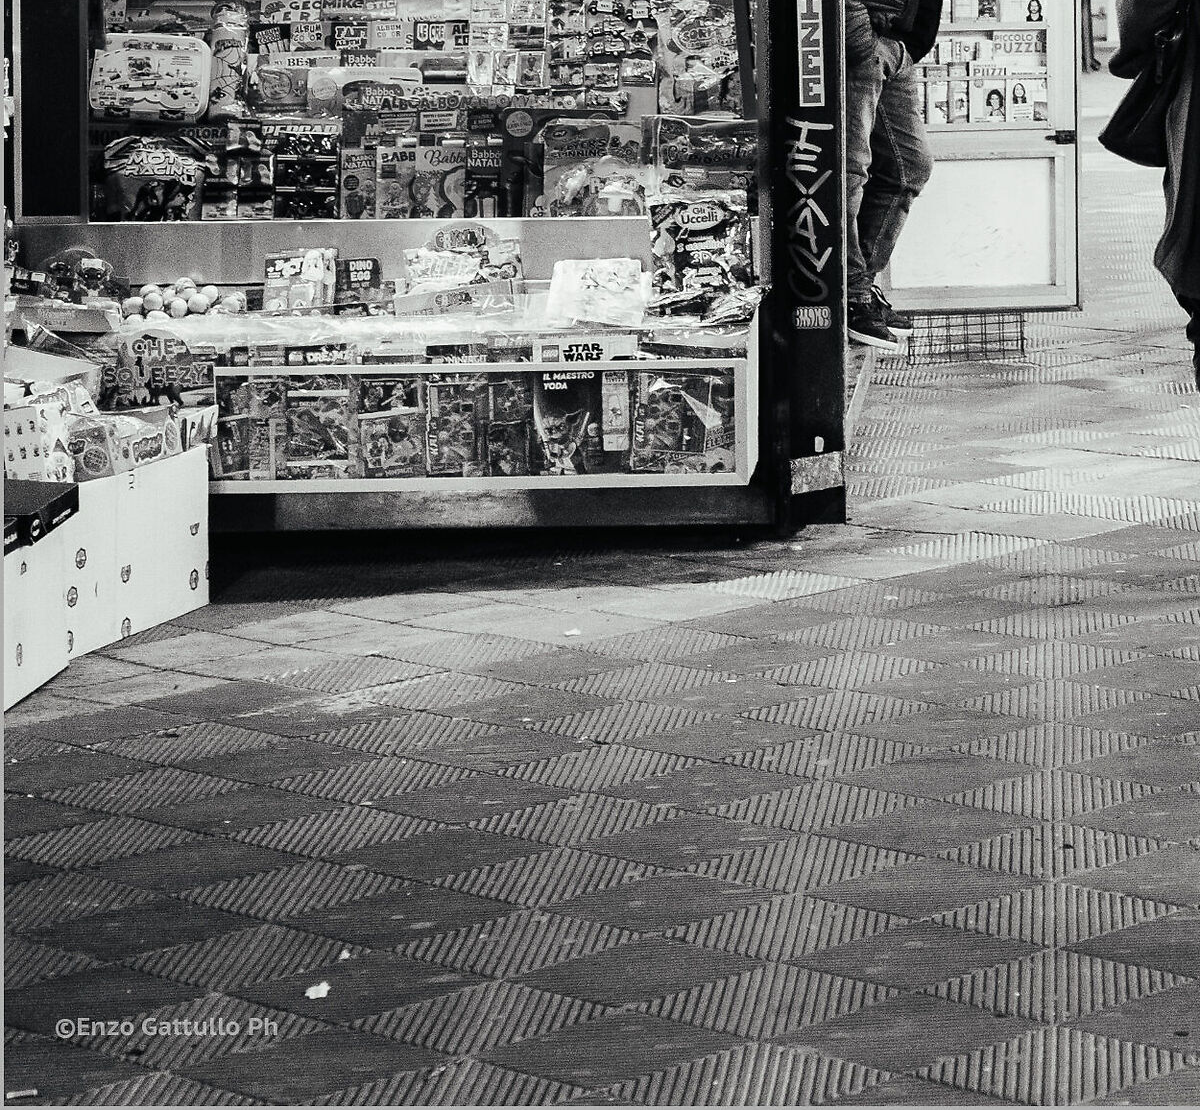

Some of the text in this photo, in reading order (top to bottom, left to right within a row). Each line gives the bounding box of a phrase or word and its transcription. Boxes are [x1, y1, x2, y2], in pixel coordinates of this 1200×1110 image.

[681, 212, 719, 225] Uccelli
[350, 259, 373, 271] DINO
[563, 343, 604, 354] STAR
[563, 351, 603, 362] WARS
[553, 371, 595, 381] MAESTRO
[543, 381, 568, 390] YODA
